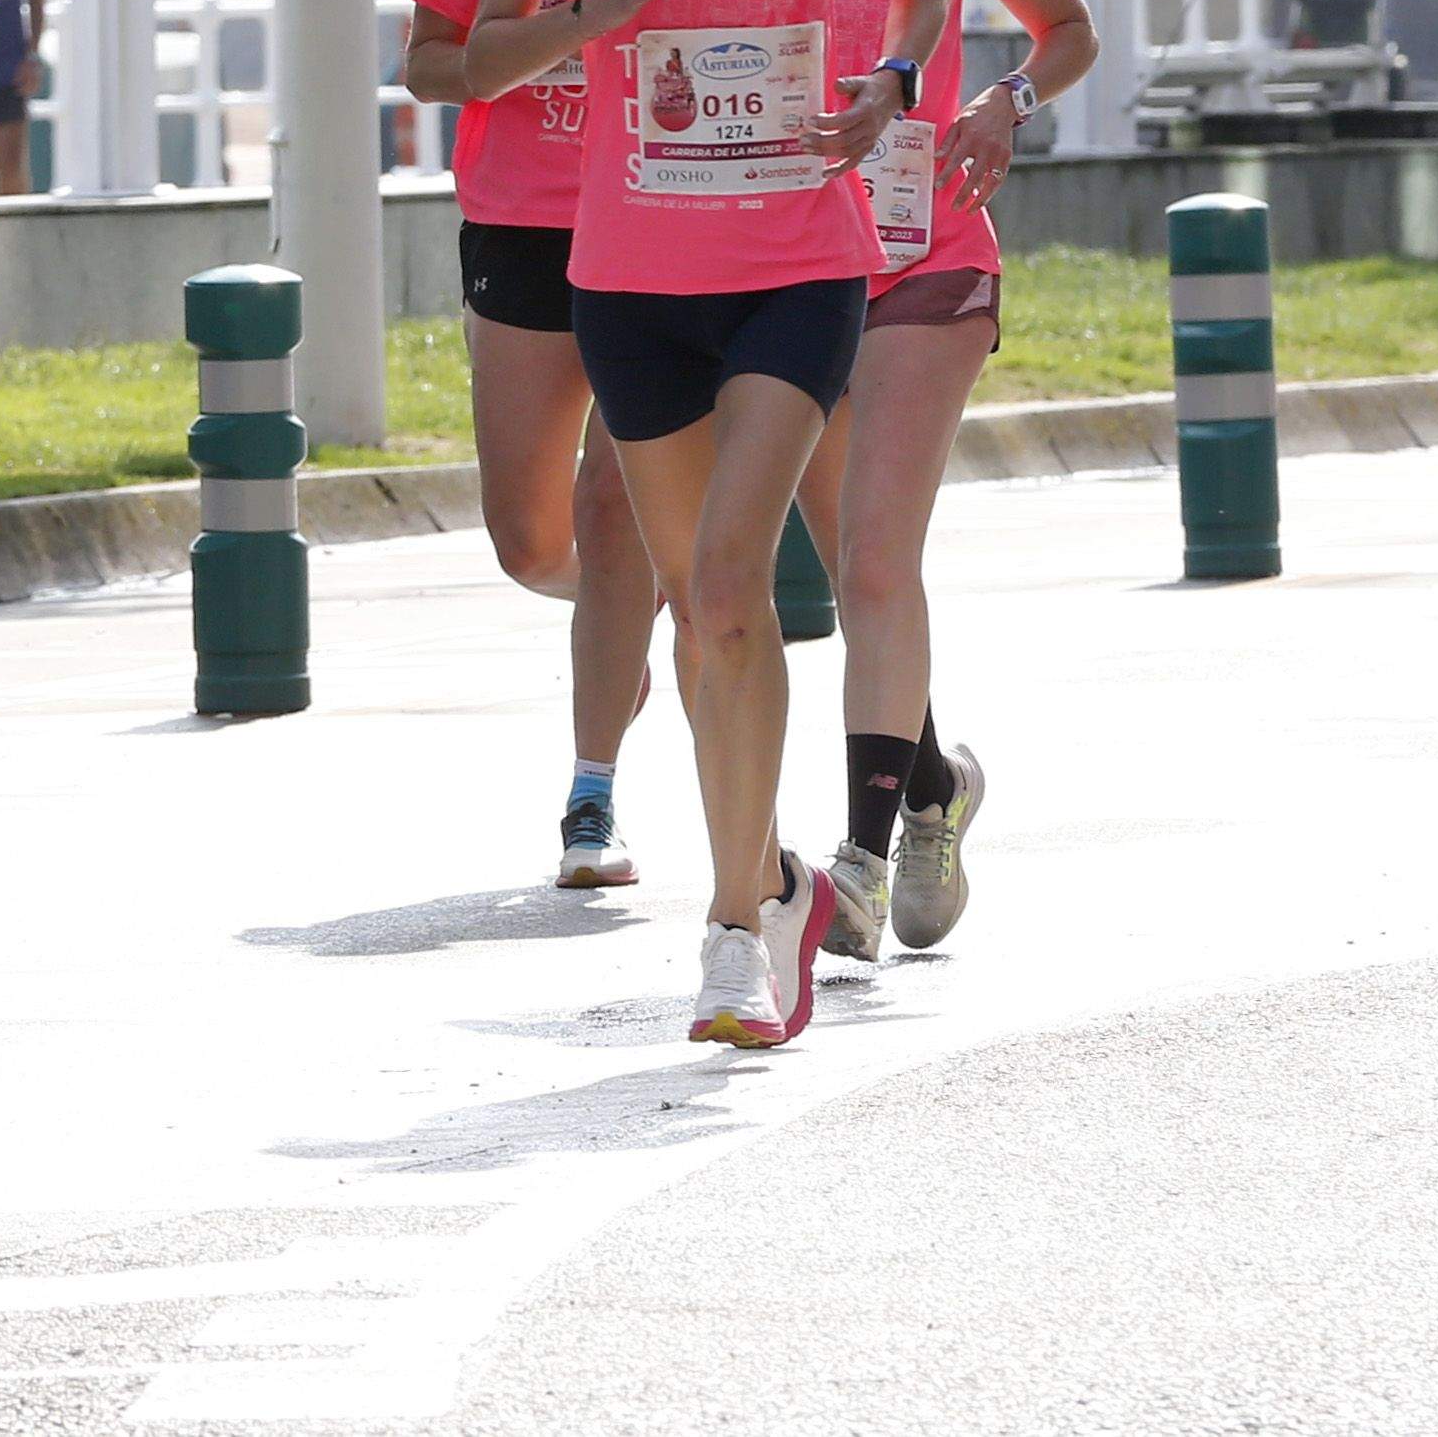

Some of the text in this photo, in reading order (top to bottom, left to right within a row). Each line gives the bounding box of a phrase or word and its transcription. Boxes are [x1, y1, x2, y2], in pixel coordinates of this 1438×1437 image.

[698, 56, 766, 73] ASTURIANA
[702, 92, 764, 118] 016
[715, 124, 754, 139] 1274
[662, 146, 712, 158] CARRERA
[714, 148, 729, 158] DE
[731, 147, 746, 157] LA
[747, 144, 782, 156] MUJER
[893, 139, 924, 151] SUMA
[657, 166, 813, 183] OYSHO Santander
[623, 195, 661, 208] CARRERA
